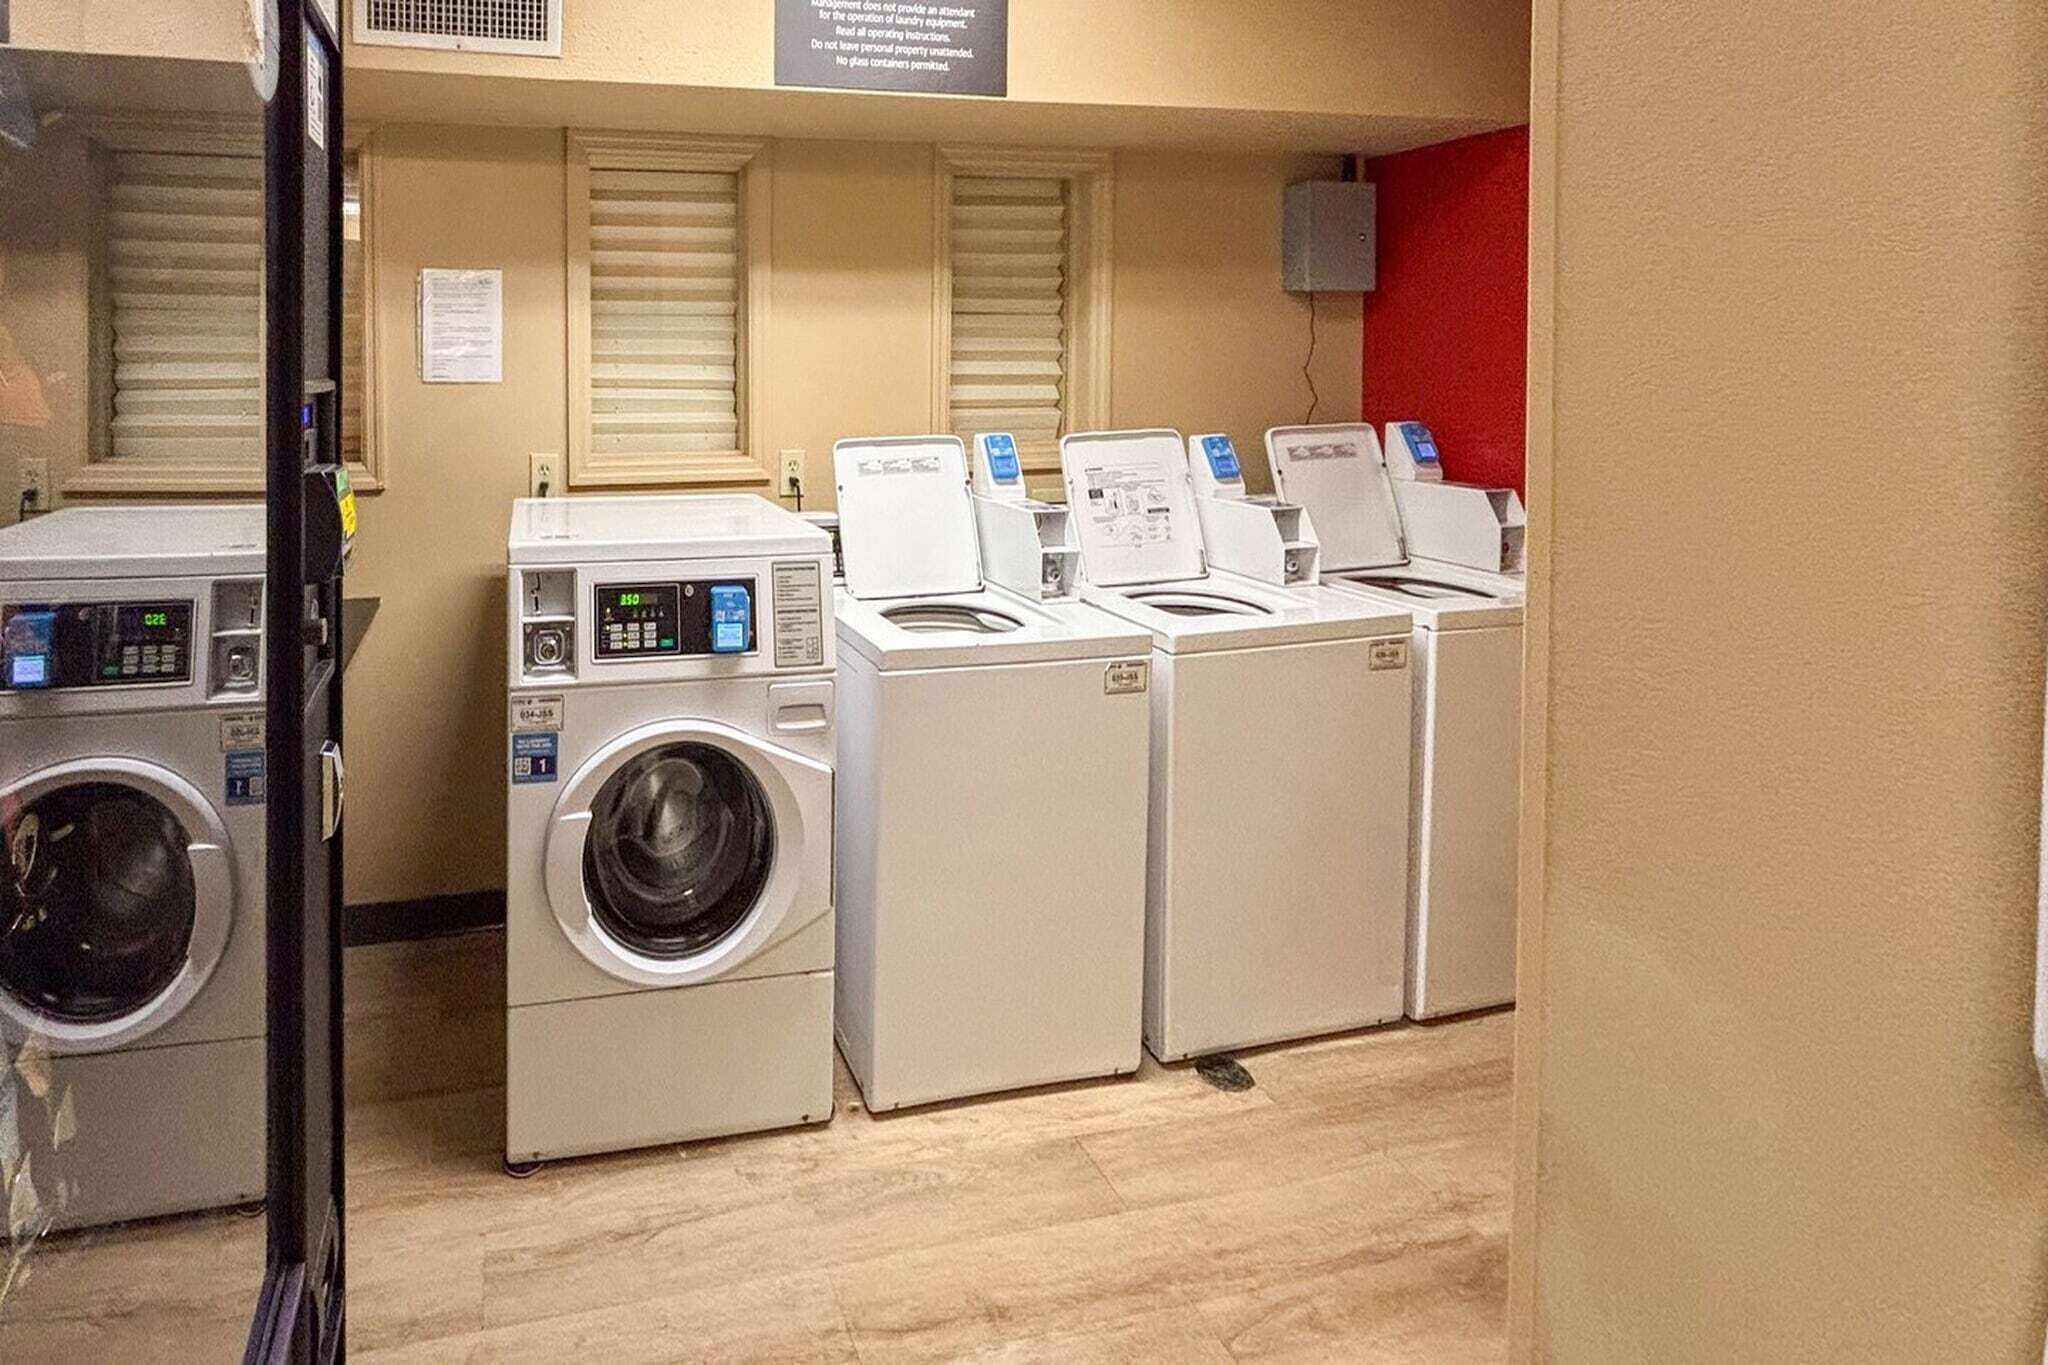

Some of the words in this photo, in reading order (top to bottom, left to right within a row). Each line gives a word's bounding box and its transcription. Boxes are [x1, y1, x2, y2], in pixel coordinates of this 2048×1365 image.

[862, 0, 881, 11] does
[883, 3, 896, 12] not
[897, 4, 926, 14] provide
[939, 7, 975, 17] attendant
[819, 9, 831, 19] for
[832, 11, 846, 20] the
[847, 13, 884, 23] operation
[885, 14, 894, 23] of
[895, 14, 924, 28] laundry
[925, 16, 968, 29] equipment.
[835, 25, 856, 36] Read
[857, 27, 866, 36] all
[867, 29, 904, 41] operating
[905, 30, 951, 42] instructions.
[811, 38, 823, 49] Do
[824, 41, 838, 50] not
[839, 40, 860, 51] leave
[860, 43, 894, 54] personal
[894, 46, 928, 57] property
[928, 47, 974, 58] unattended.
[836, 55, 848, 65] No
[849, 56, 869, 68] glass
[869, 58, 909, 69] containers
[910, 61, 950, 71] permitted.
[539, 758, 546, 773] 1
